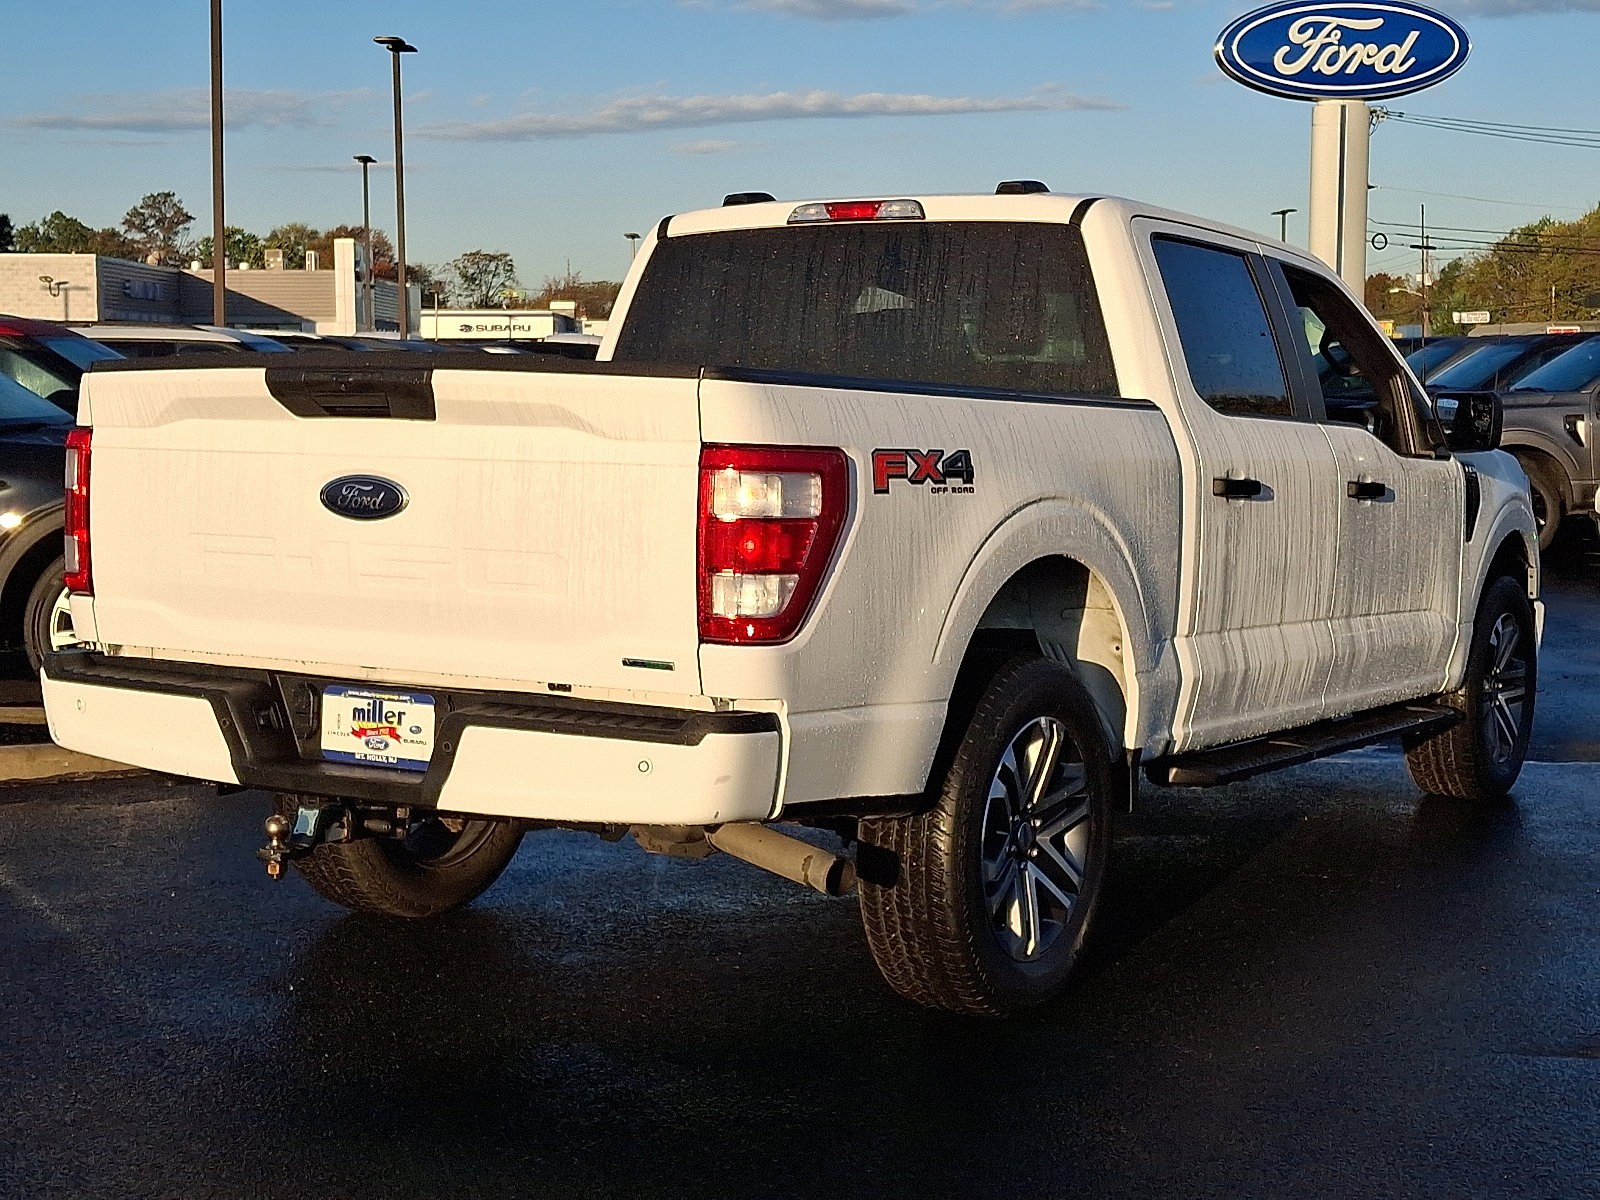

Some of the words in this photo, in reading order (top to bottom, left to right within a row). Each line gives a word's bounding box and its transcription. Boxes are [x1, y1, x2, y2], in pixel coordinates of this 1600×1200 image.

[1273, 16, 1421, 75] Ford
[475, 324, 531, 332] SUBARU
[871, 448, 975, 495] FX4
[337, 483, 386, 510] Ford
[930, 486, 949, 494] OFF
[951, 486, 975, 494] ROAD
[352, 699, 407, 726] miller
